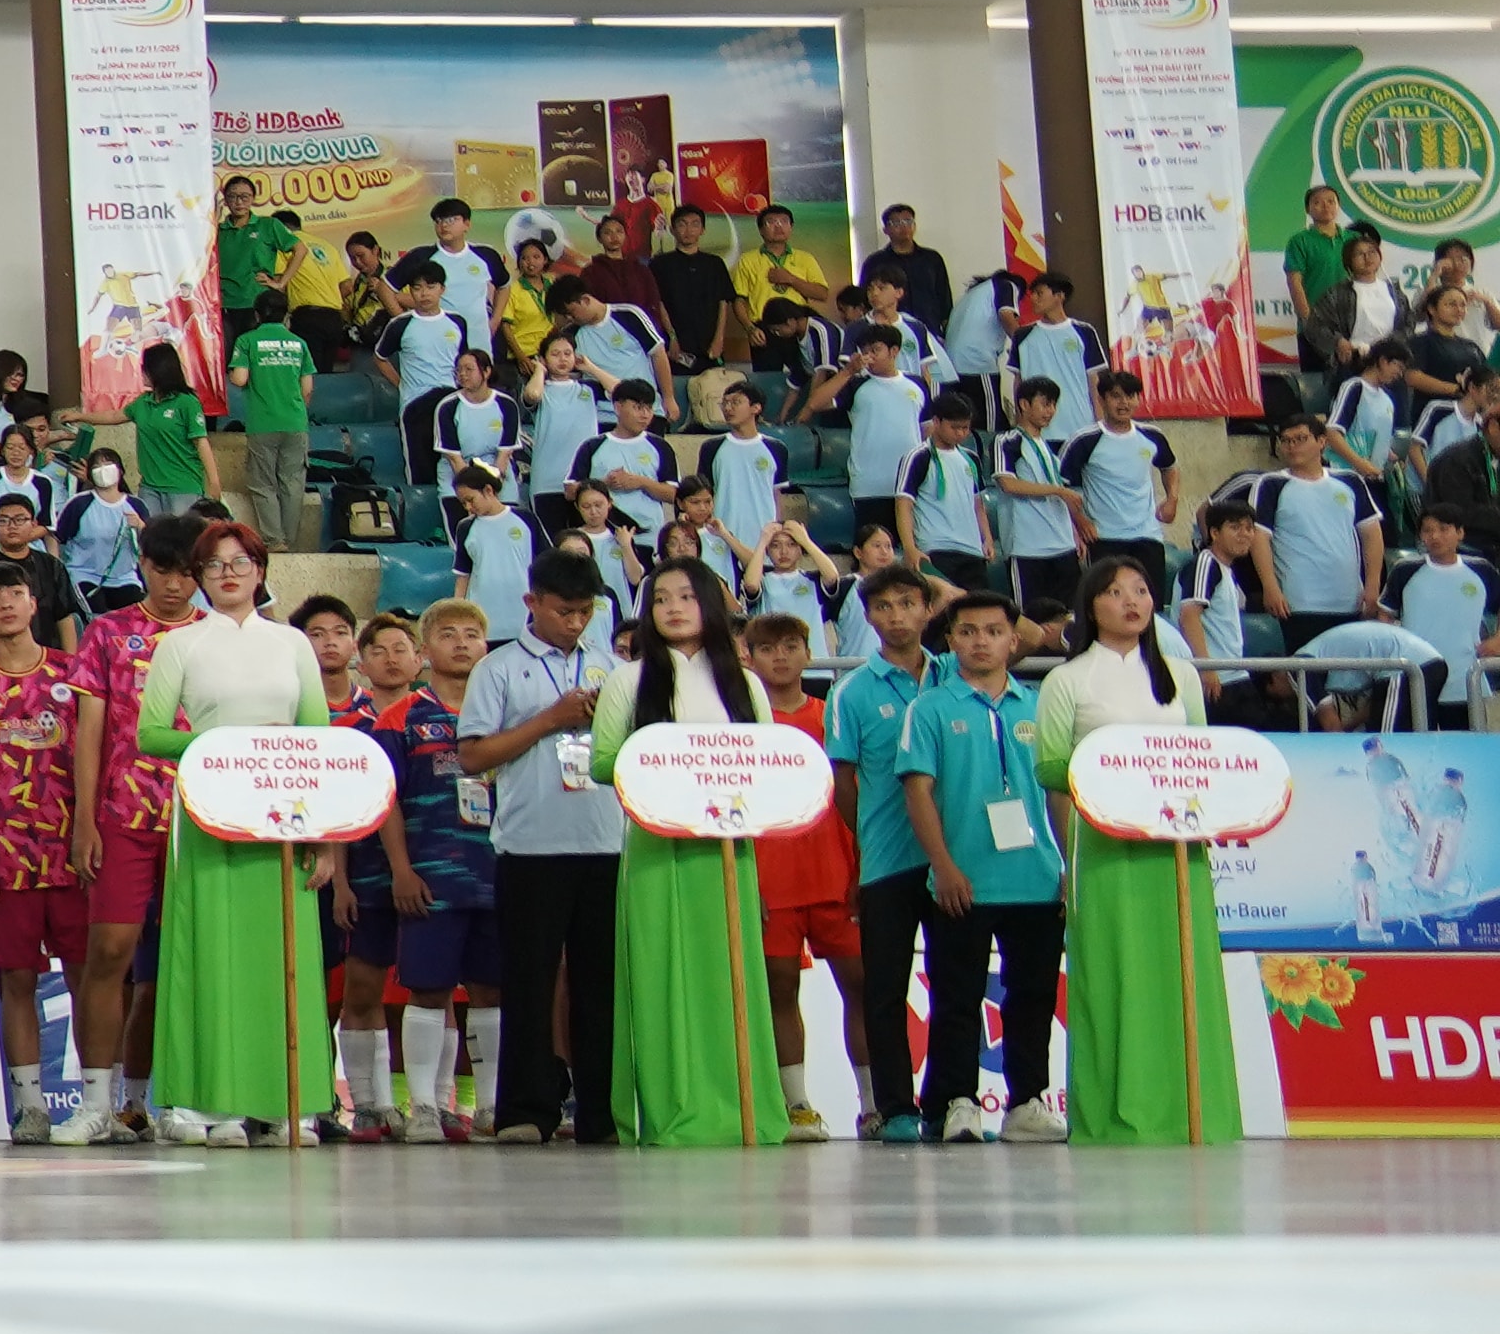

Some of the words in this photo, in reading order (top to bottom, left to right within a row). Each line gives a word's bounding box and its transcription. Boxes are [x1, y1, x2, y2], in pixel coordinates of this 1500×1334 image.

[212, 111, 250, 132] Thẻ
[255, 108, 343, 133] HDBank
[269, 137, 328, 165] NGÔI
[329, 135, 380, 161] VUA
[88, 202, 176, 220] HDBank
[1115, 203, 1206, 223] HDBank
[252, 735, 318, 751] TRƯỜNG
[687, 731, 754, 748] TRƯỜNG
[1143, 734, 1212, 751] TRƯỜNG
[203, 757, 229, 773] ĐẠI
[234, 757, 268, 773] HỌC
[273, 755, 321, 771] CÔNG
[326, 755, 369, 775] NGHỆ
[640, 753, 665, 770] ĐẠI
[671, 753, 705, 770] HỌC
[711, 750, 755, 766] NGÂN
[761, 751, 806, 767] HÀNG
[1100, 754, 1127, 771] ĐẠI
[1132, 755, 1167, 772] HỌC
[1172, 753, 1220, 770] NÔNG
[1225, 754, 1259, 771] LÂM
[254, 774, 279, 789] SÀI
[283, 774, 319, 789] GÒN
[694, 773, 753, 786] TP.HCM
[1150, 774, 1209, 790] TP.HCM
